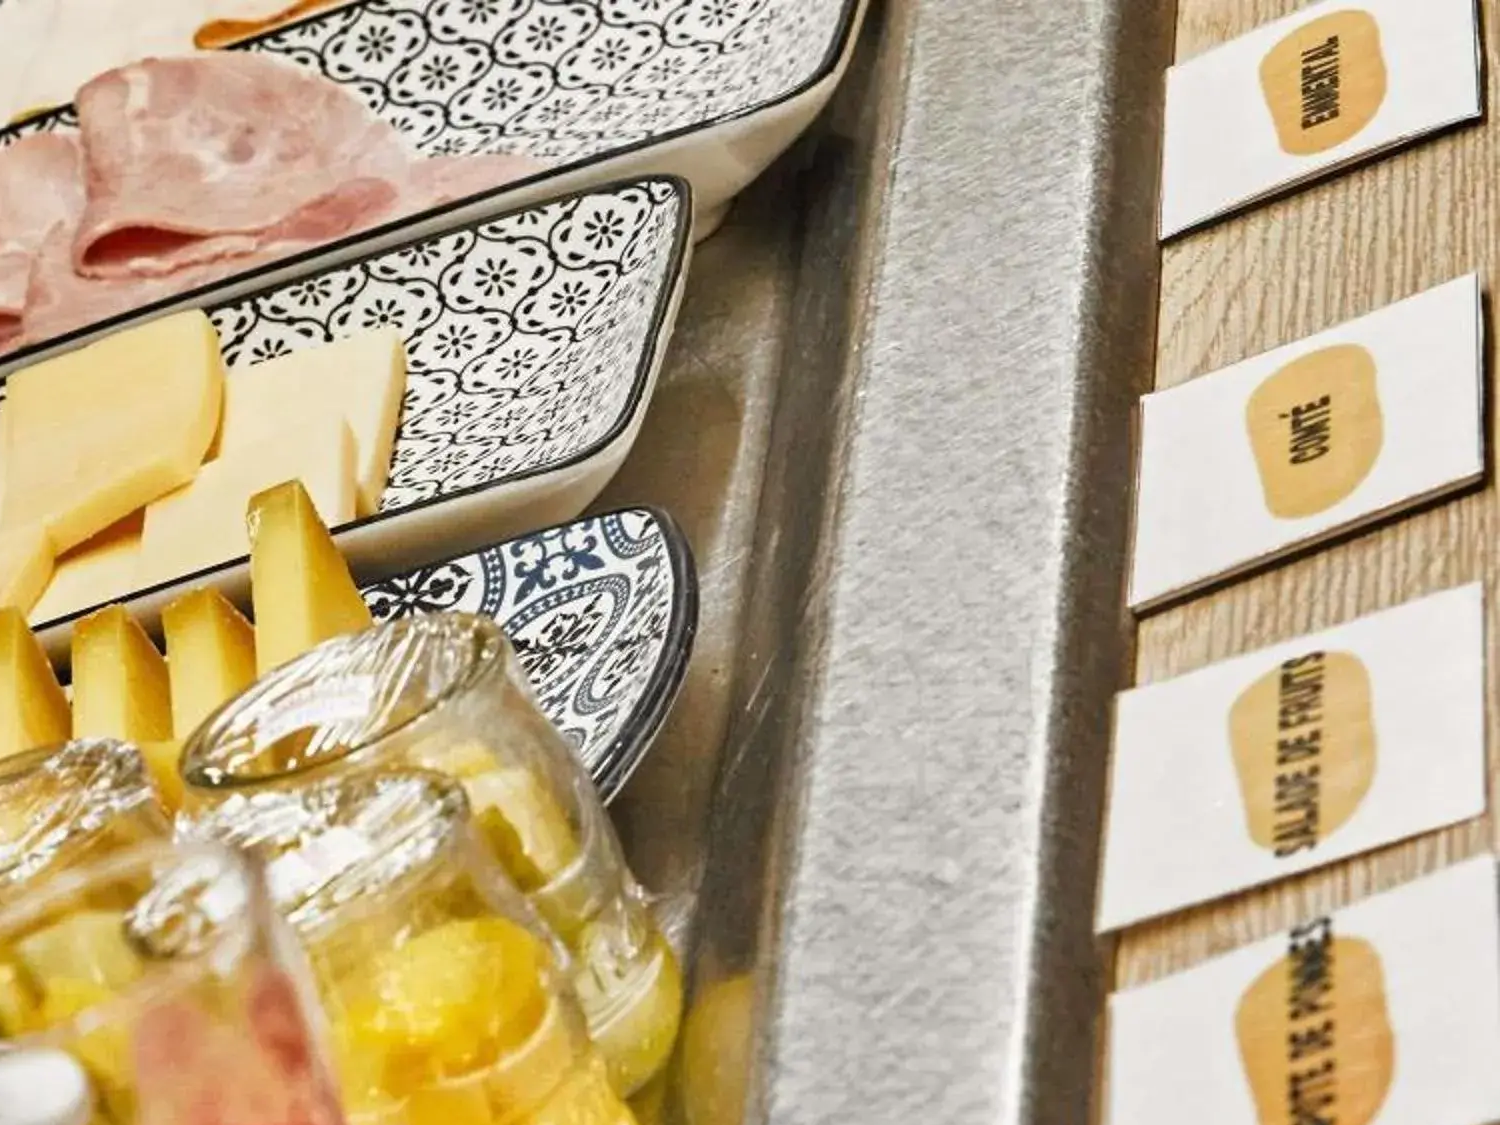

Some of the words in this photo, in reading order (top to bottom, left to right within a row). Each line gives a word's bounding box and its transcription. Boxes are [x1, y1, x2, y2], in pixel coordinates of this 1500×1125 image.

[1301, 35, 1339, 130] EMMENTAL
[1279, 394, 1331, 465] COMTÉ
[1278, 651, 1325, 731] FRUITS
[1275, 730, 1321, 766] DE
[1273, 766, 1320, 858] SALADE
